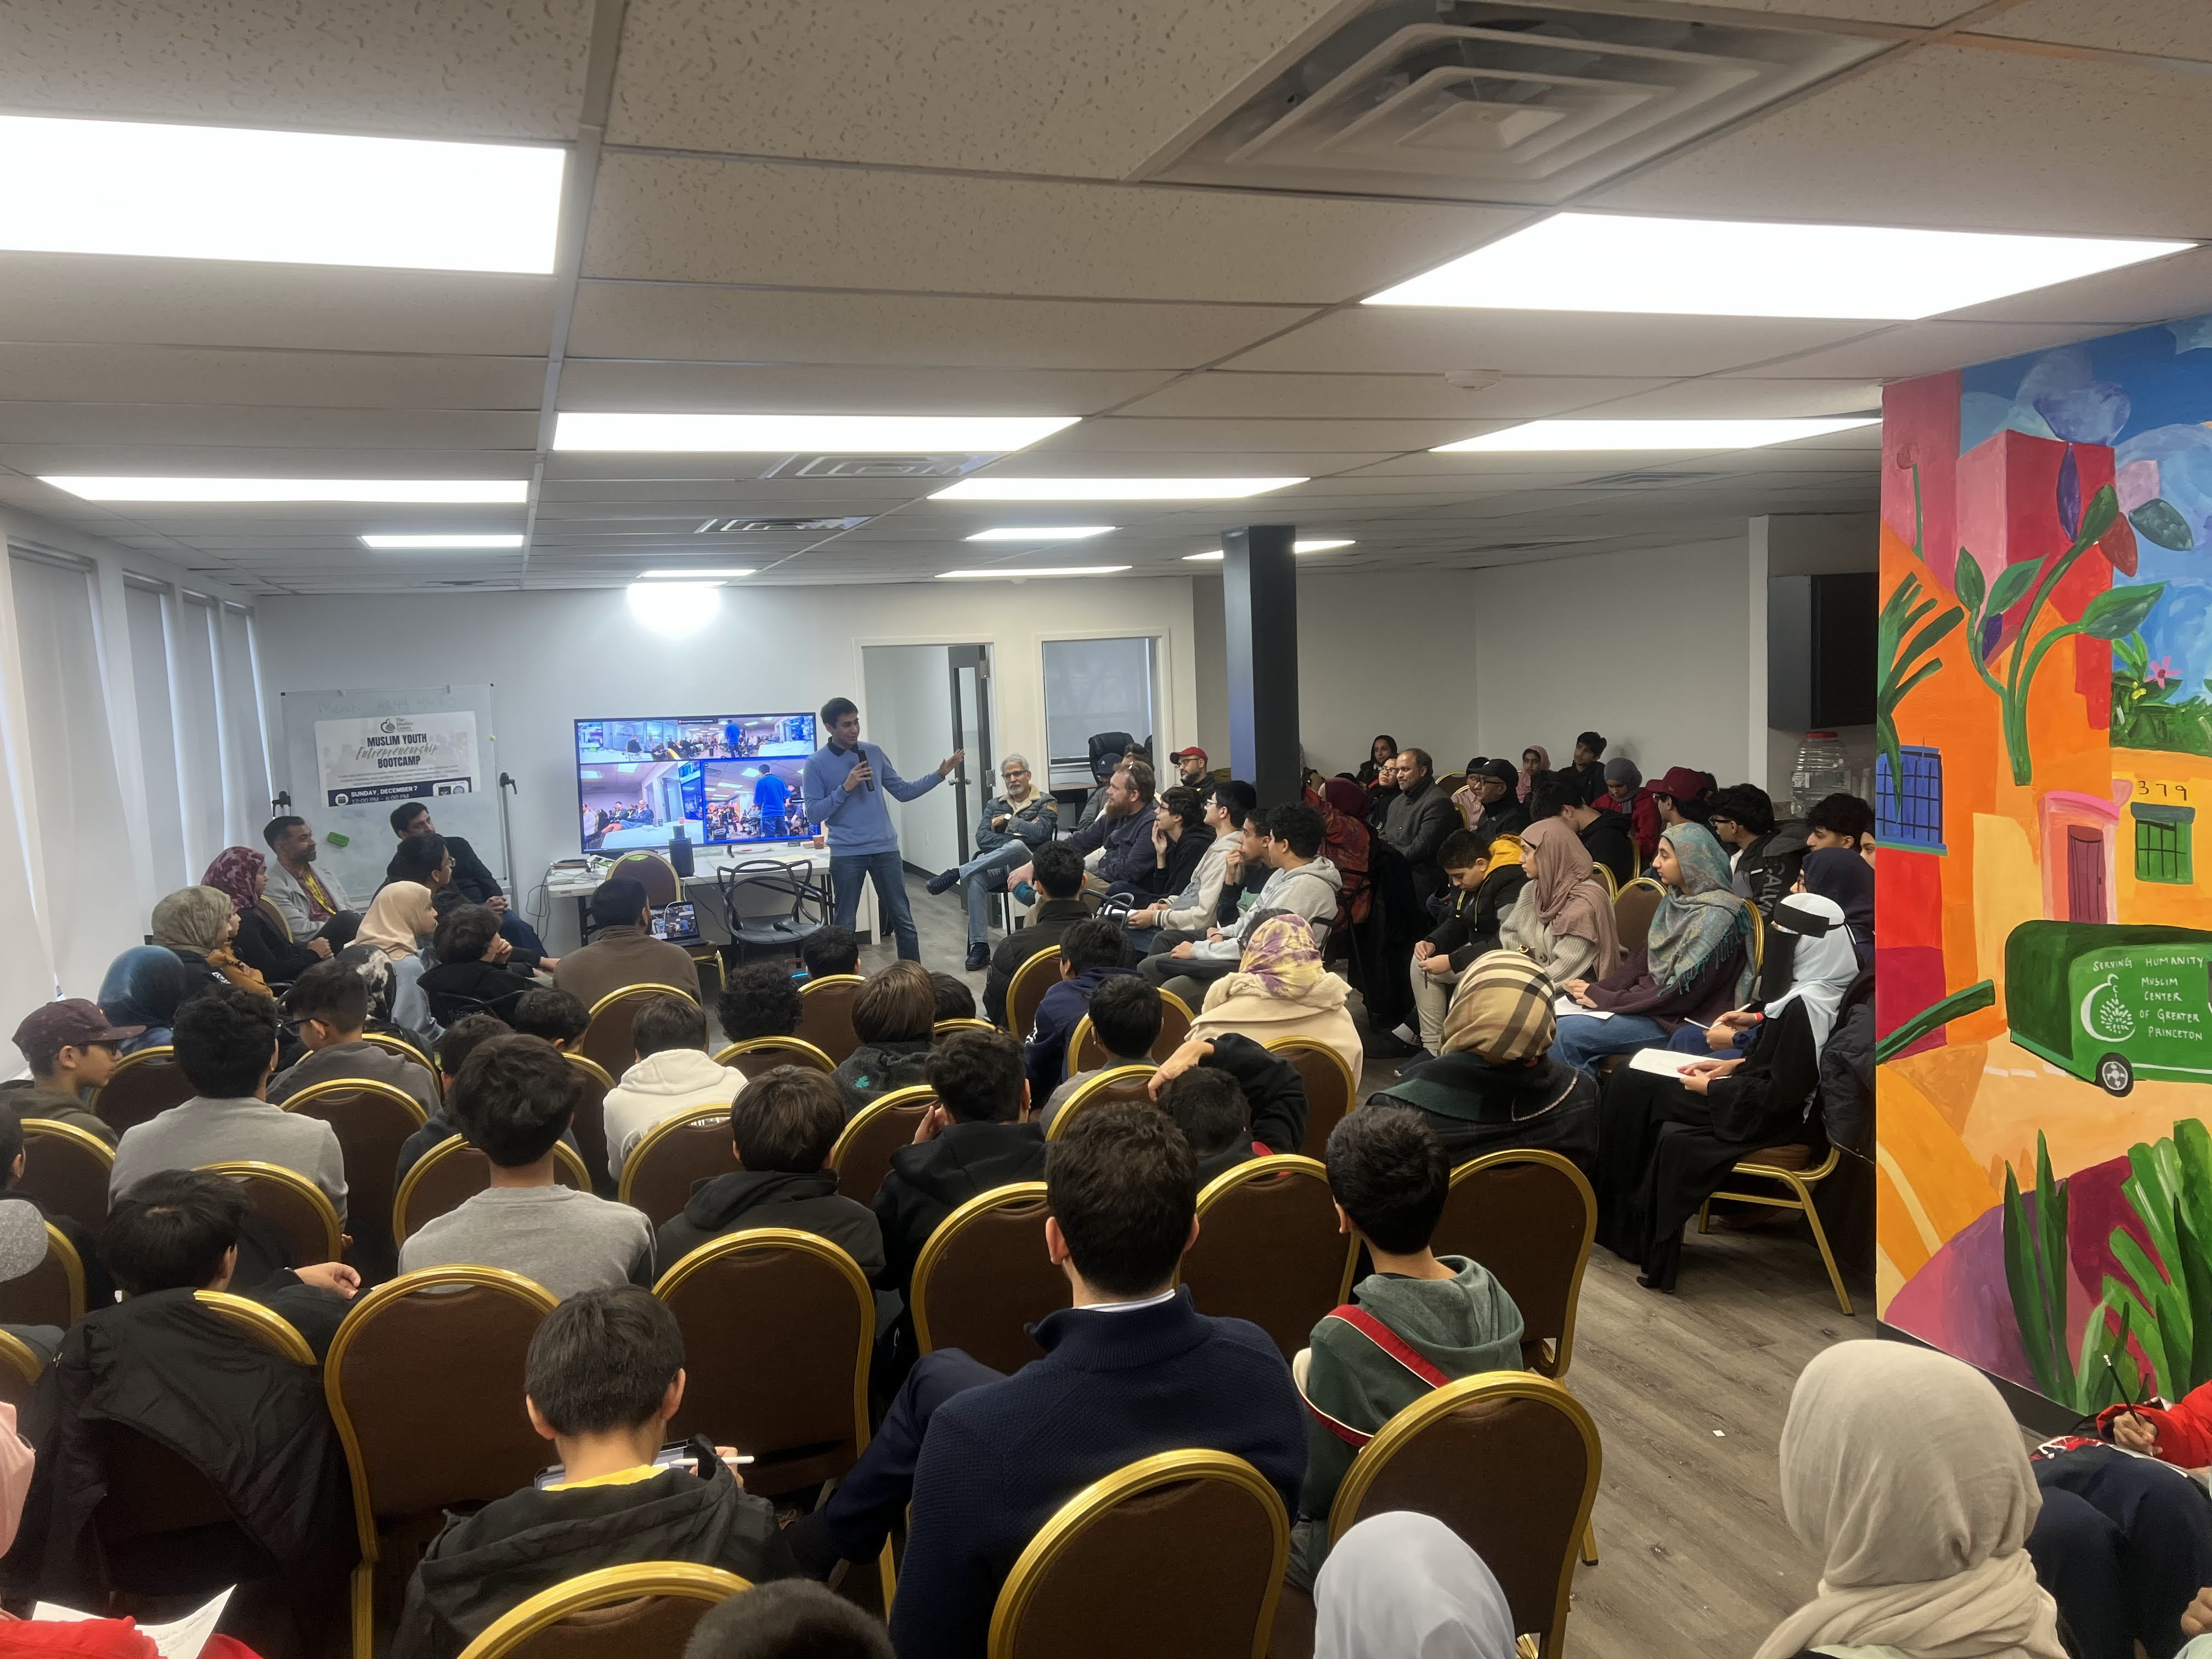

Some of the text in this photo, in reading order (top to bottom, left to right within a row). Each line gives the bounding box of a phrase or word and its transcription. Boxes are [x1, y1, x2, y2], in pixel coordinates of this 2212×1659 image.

[367, 733, 427, 747] MUSLIM YOUTH
[356, 742, 438, 760] Entrepreneurship
[377, 755, 421, 768] BOOTCAMP
[380, 786, 413, 794] DECEMBER
[2137, 780, 2188, 802] 379
[2093, 956, 2204, 972] SERVING HUMANITY
[2141, 977, 2179, 987] MUSLIM
[2144, 991, 2183, 1002] CENTER
[2139, 1008, 2200, 1023] OF GREATER
[2148, 1025, 2203, 1041] PRINCETON
